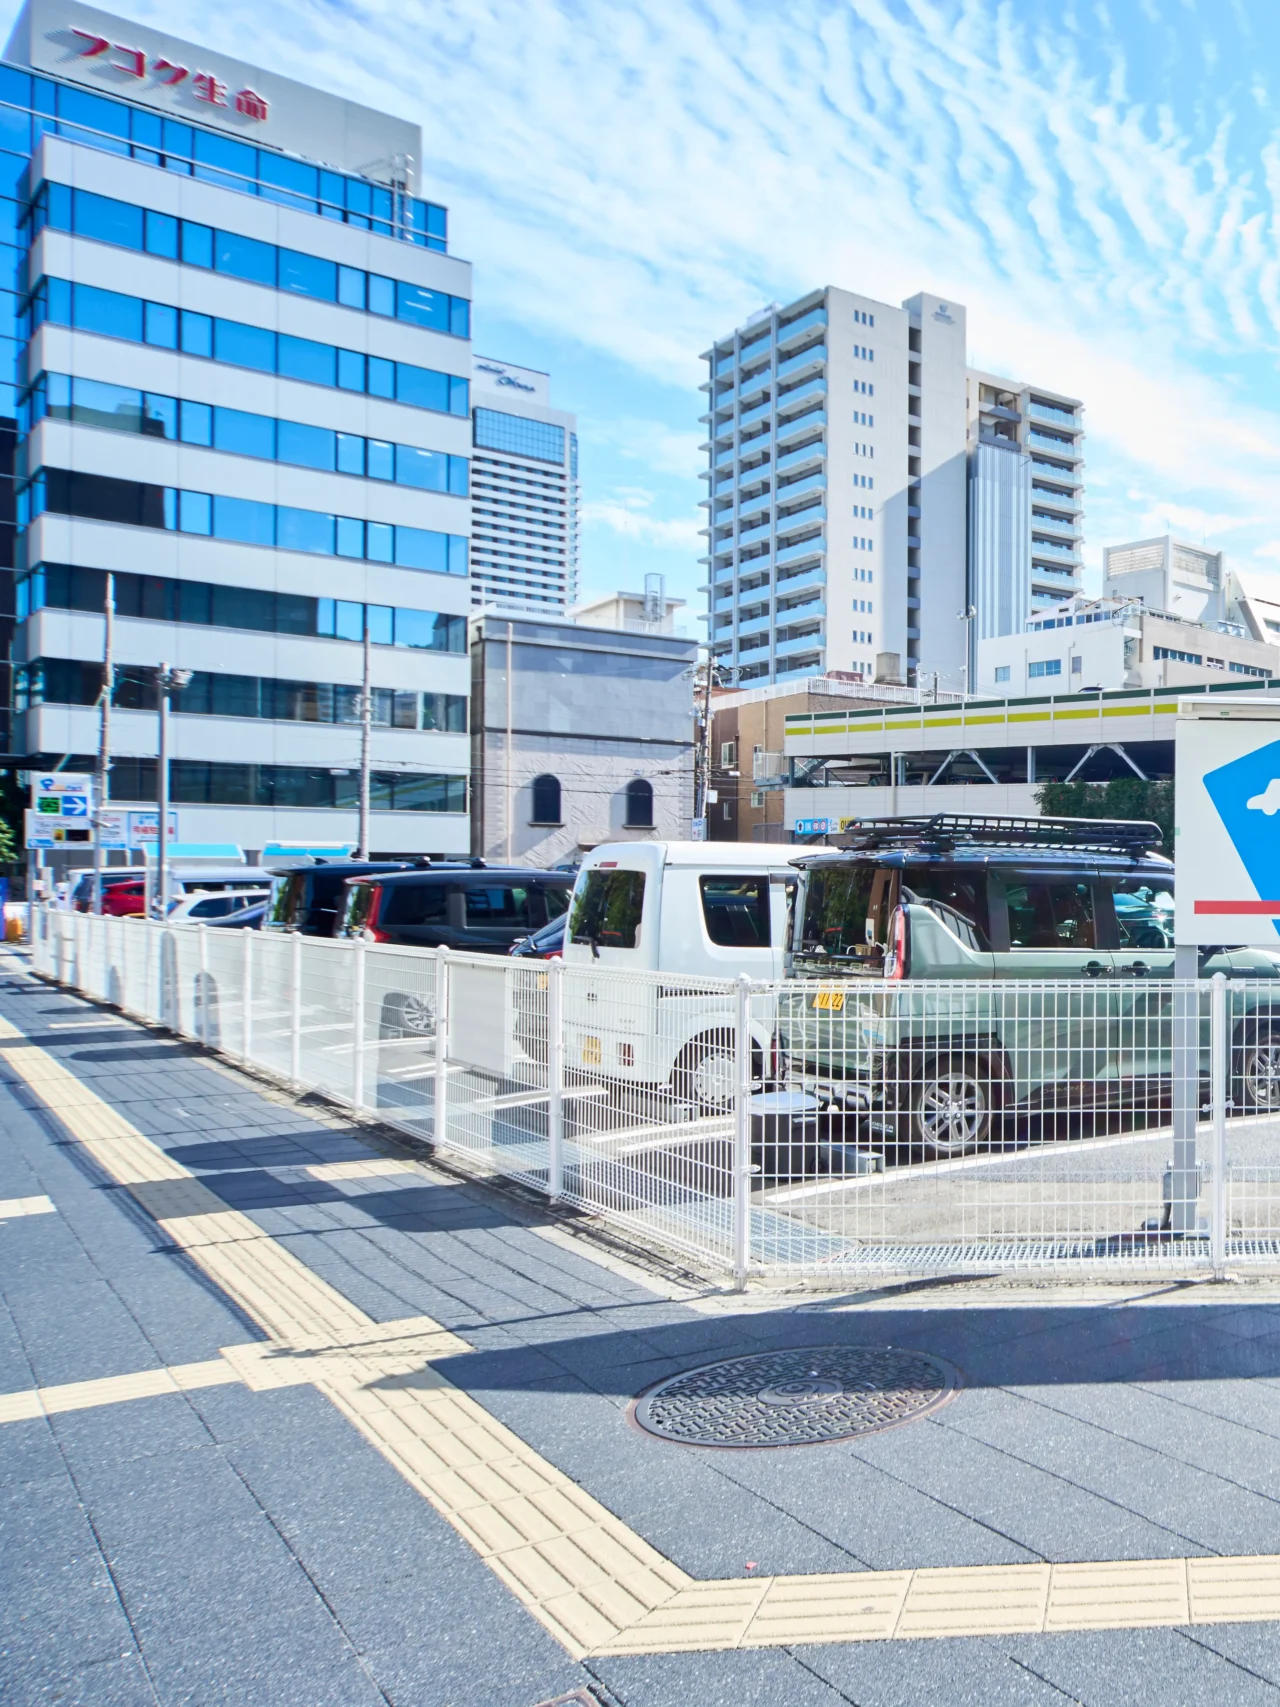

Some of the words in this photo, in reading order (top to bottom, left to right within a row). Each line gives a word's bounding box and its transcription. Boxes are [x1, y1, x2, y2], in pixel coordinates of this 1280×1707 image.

[70, 26, 269, 120] フコク生命
